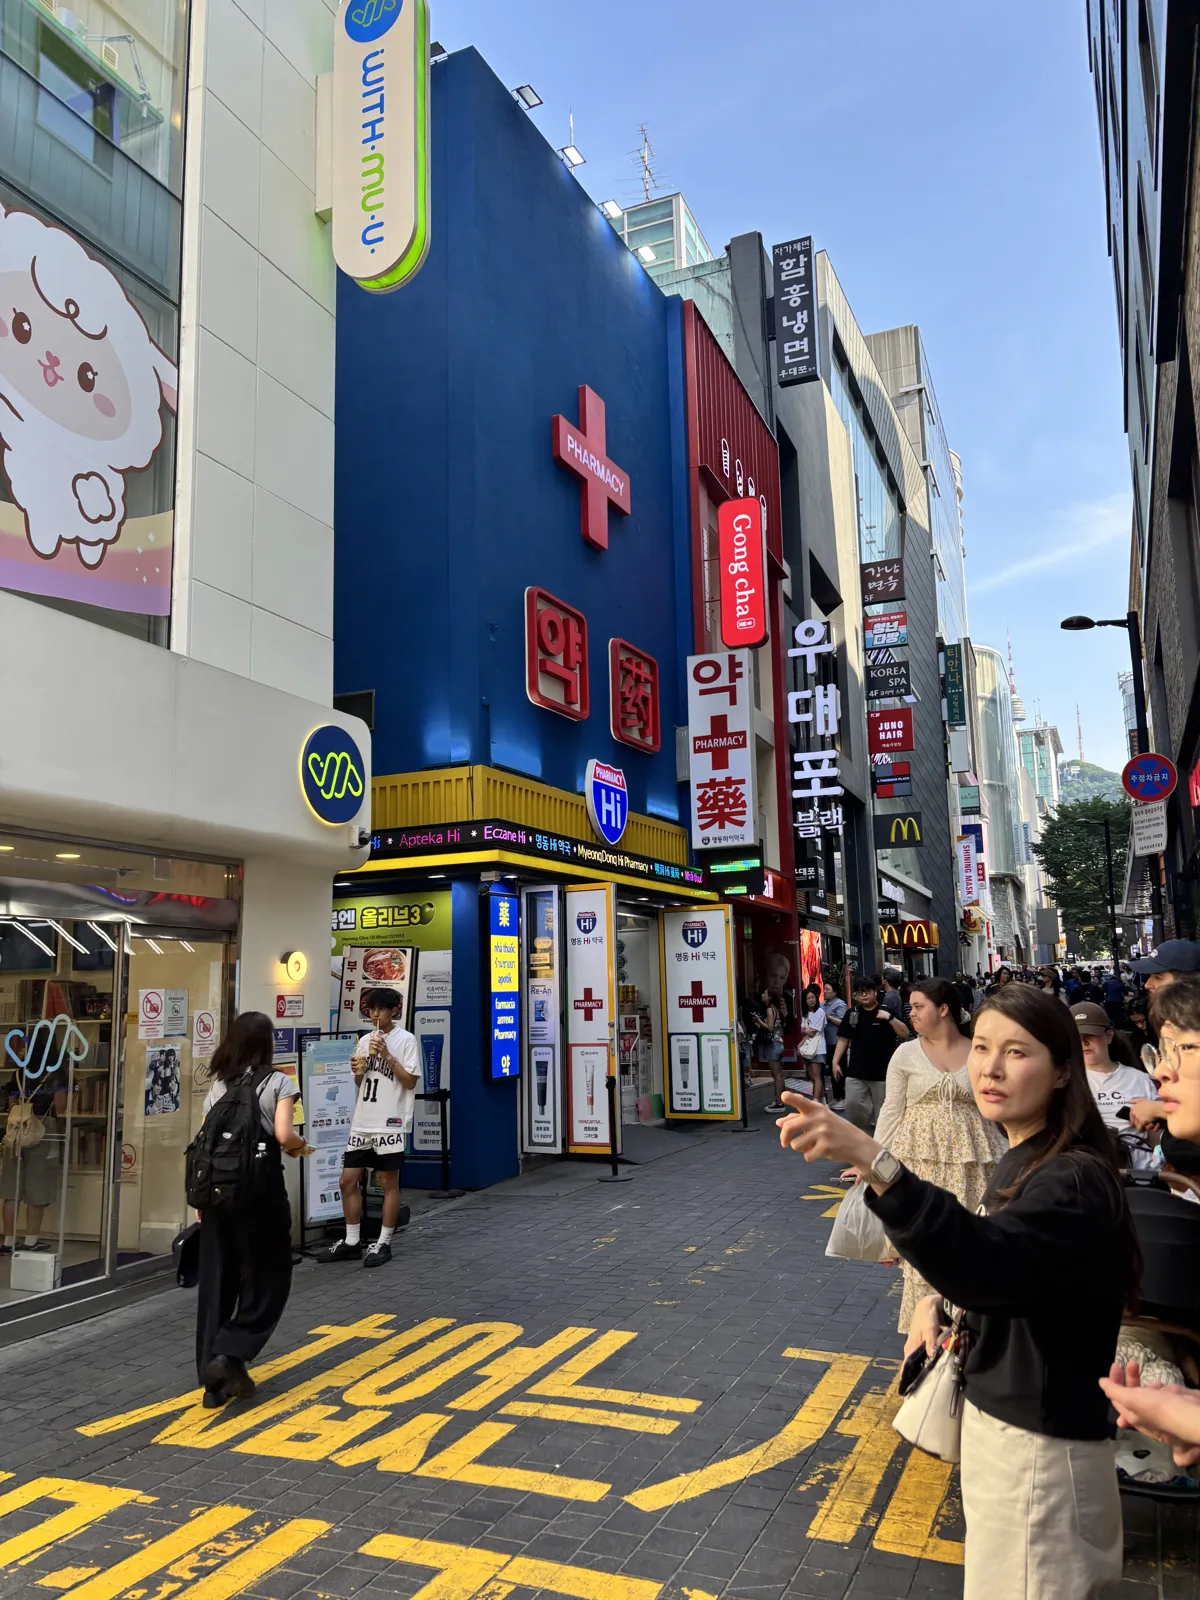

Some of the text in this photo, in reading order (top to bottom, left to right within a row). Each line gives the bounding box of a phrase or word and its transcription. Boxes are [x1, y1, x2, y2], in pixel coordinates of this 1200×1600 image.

[774, 239, 810, 256] 자가제면
[779, 253, 810, 364] 함흥냉면
[779, 364, 808, 378] 우대포
[567, 434, 625, 497] PHARMACY
[728, 513, 756, 617] Gong cha
[864, 563, 900, 578] 강남
[868, 575, 899, 592] 면옥
[864, 594, 874, 602] 5F
[872, 621, 899, 635] 청년
[872, 632, 900, 646] 다방
[537, 607, 582, 705] 약
[870, 666, 907, 678] KOREA
[947, 646, 961, 685] 티안나
[692, 654, 743, 706] 약
[888, 677, 907, 687] SPA
[868, 689, 879, 697] 4F
[787, 618, 844, 799] 우대포
[878, 720, 904, 731] JUNO
[695, 735, 744, 749] PHARMACY
[879, 730, 903, 740] HAIR
[595, 766, 623, 787] PHARMACY
[1130, 772, 1169, 783] 주정차금지
[601, 788, 622, 830] Hi
[696, 776, 748, 832] 藥
[793, 807, 846, 839] 블랙
[399, 832, 443, 849] Apteka
[447, 828, 460, 843] Hi
[483, 825, 526, 845] Eczane Hi
[535, 833, 571, 857] 명동 Hi 약국
[577, 843, 649, 874] MyeongDong Hi Pharmacy
[962, 844, 974, 896] SHINING MASK
[361, 905, 421, 929] 올리브3
[580, 918, 593, 931] Hi
[570, 936, 604, 946] 명동 Hi 약국
[687, 929, 703, 943] Hi
[675, 951, 716, 962] 명동 Hi 약국
[344, 960, 357, 1012] 부뚜막
[530, 985, 552, 995] Re-An
[680, 997, 715, 1006] PHARMACY
[494, 1028, 517, 1041] Pharmacy
[501, 1054, 511, 1076] 약
